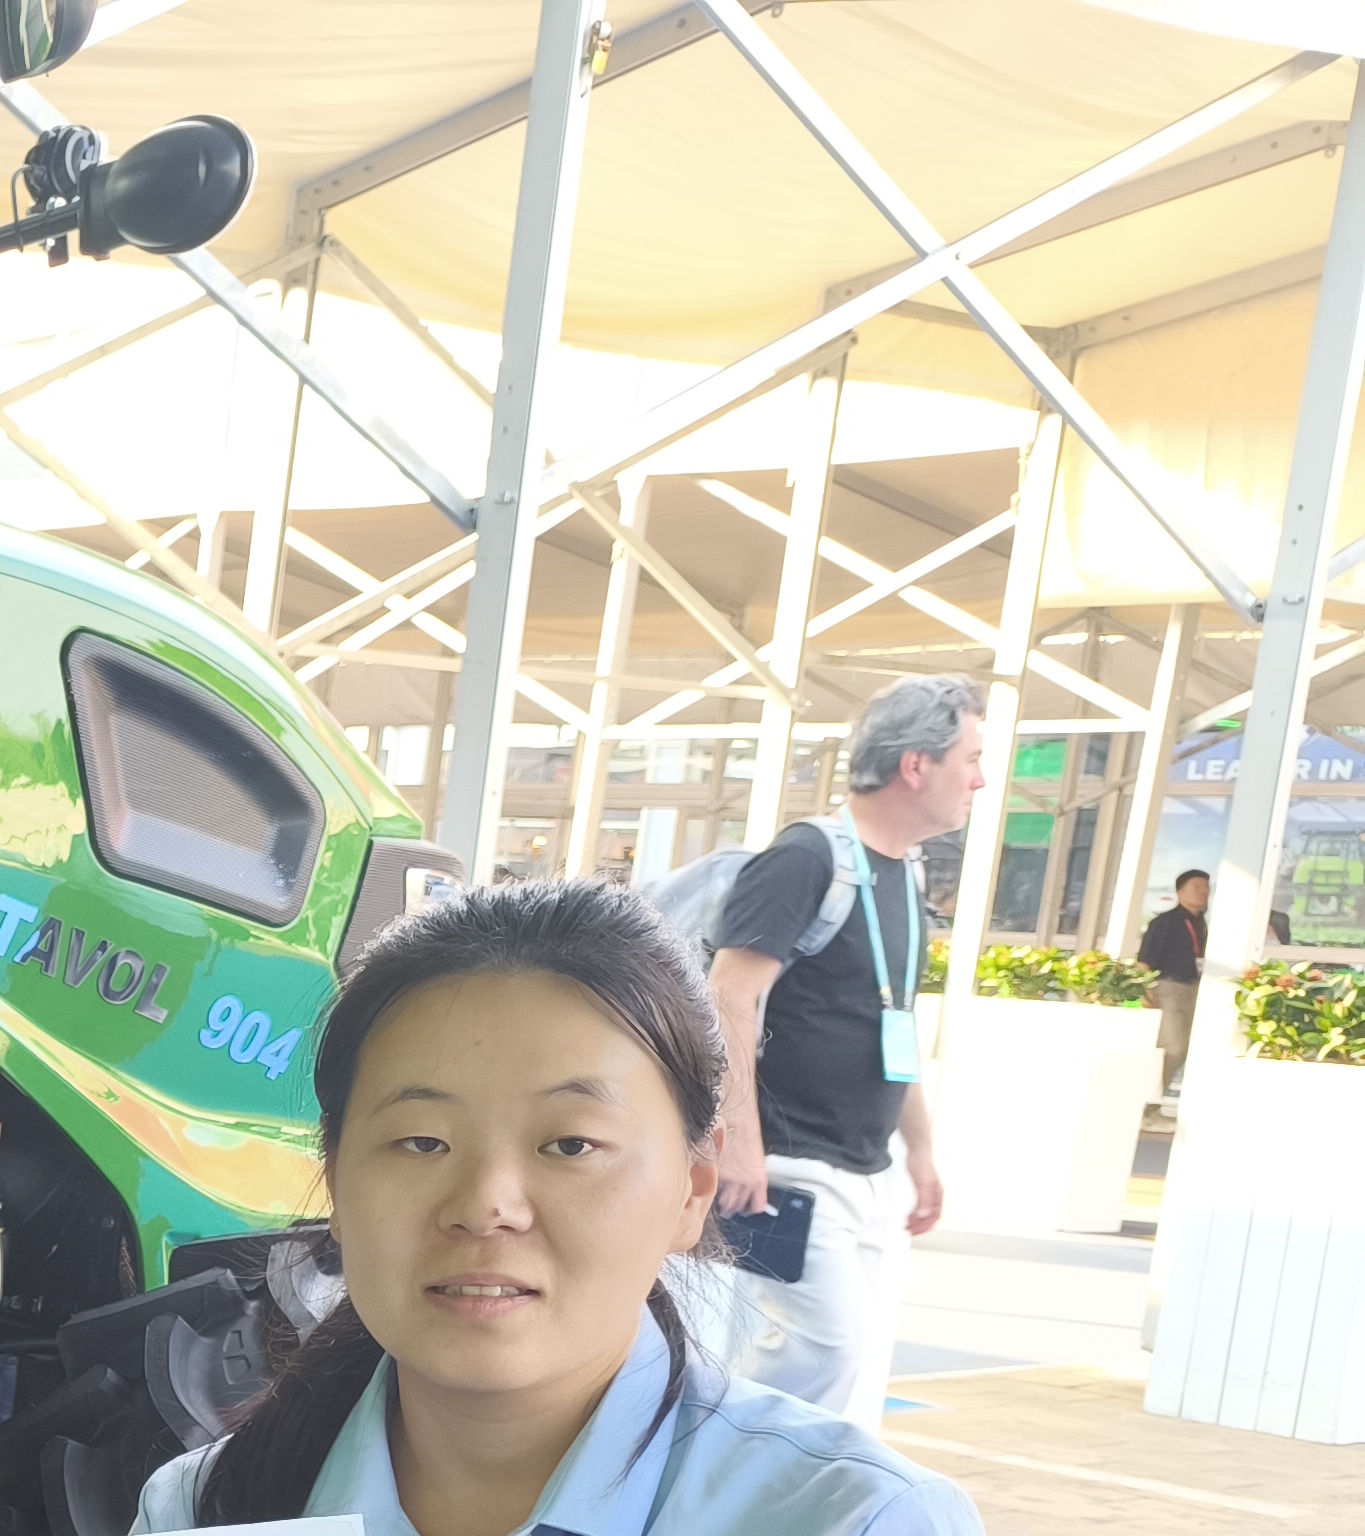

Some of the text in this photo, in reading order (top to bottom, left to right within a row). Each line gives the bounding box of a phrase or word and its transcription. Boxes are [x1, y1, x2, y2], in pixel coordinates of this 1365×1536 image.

[1186, 758, 1355, 781] LEAR IN
[198, 994, 305, 1082] 904
